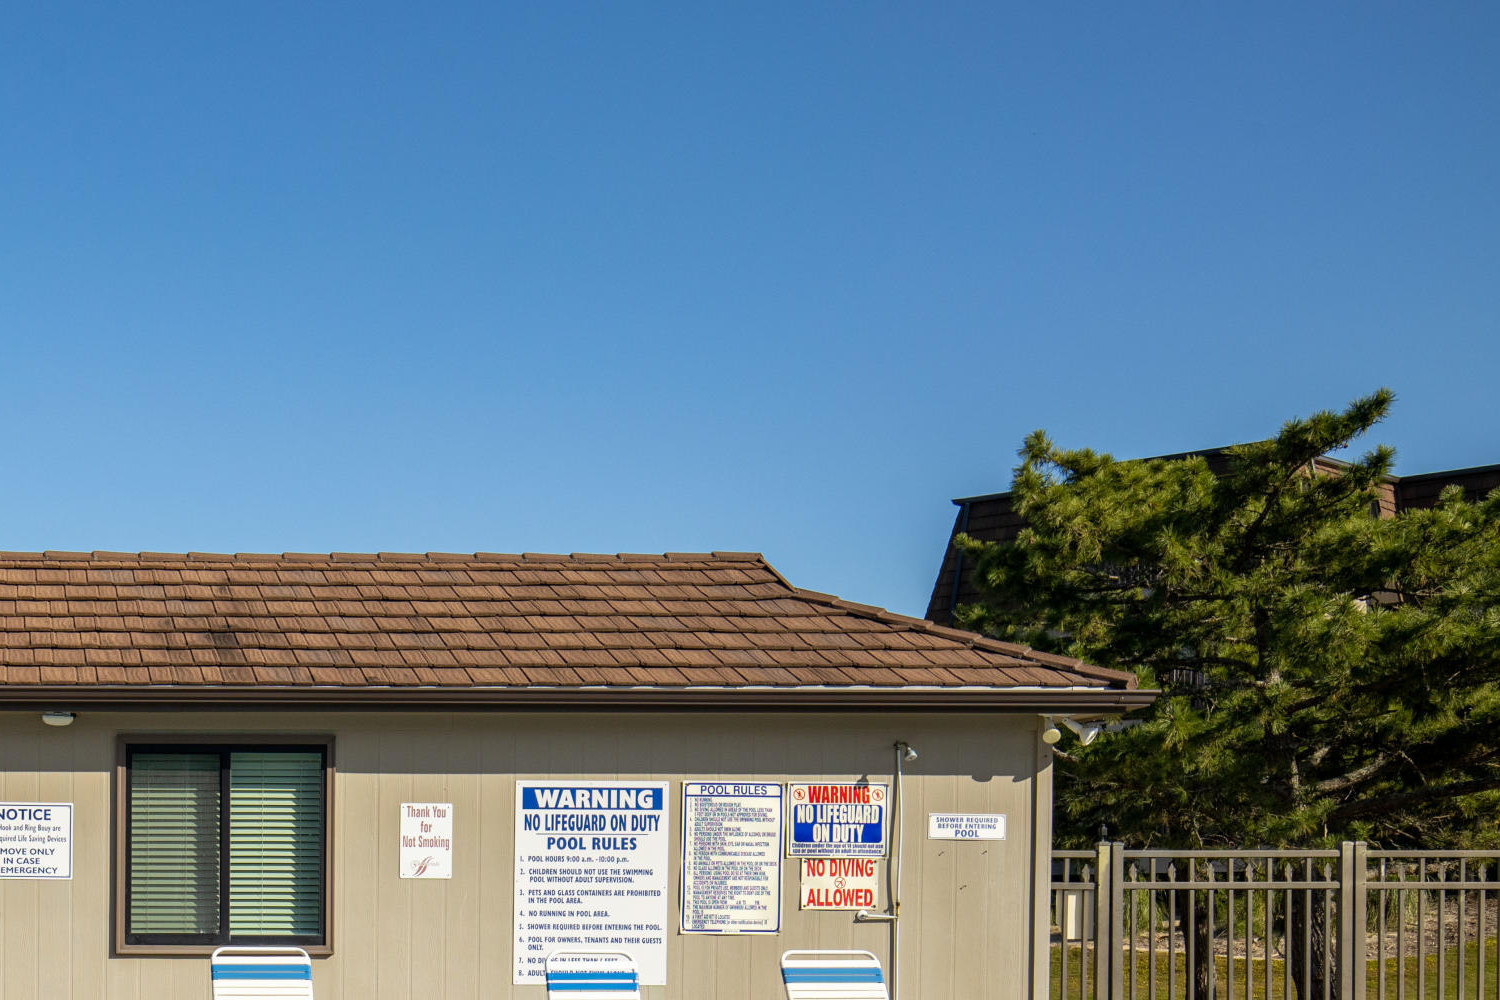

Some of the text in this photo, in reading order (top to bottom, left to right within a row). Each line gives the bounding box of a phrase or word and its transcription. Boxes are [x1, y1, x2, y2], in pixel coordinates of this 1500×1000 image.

[534, 789, 653, 808] WARNING
[700, 786, 767, 795] POOL RULES
[808, 786, 870, 804] WARNING
[407, 806, 446, 818] Thank You
[797, 805, 879, 824] NO LIFEGUARD
[420, 821, 432, 832] for
[524, 814, 660, 832] NO LIFEGUARD ON DUTY
[29, 836, 45, 844] Saving
[813, 824, 864, 842] ON DUTY
[403, 836, 449, 850] Not Smoking
[547, 837, 637, 850] POOL RULES
[807, 860, 874, 877] NO DIVING
[807, 888, 873, 906] ALLOWED
